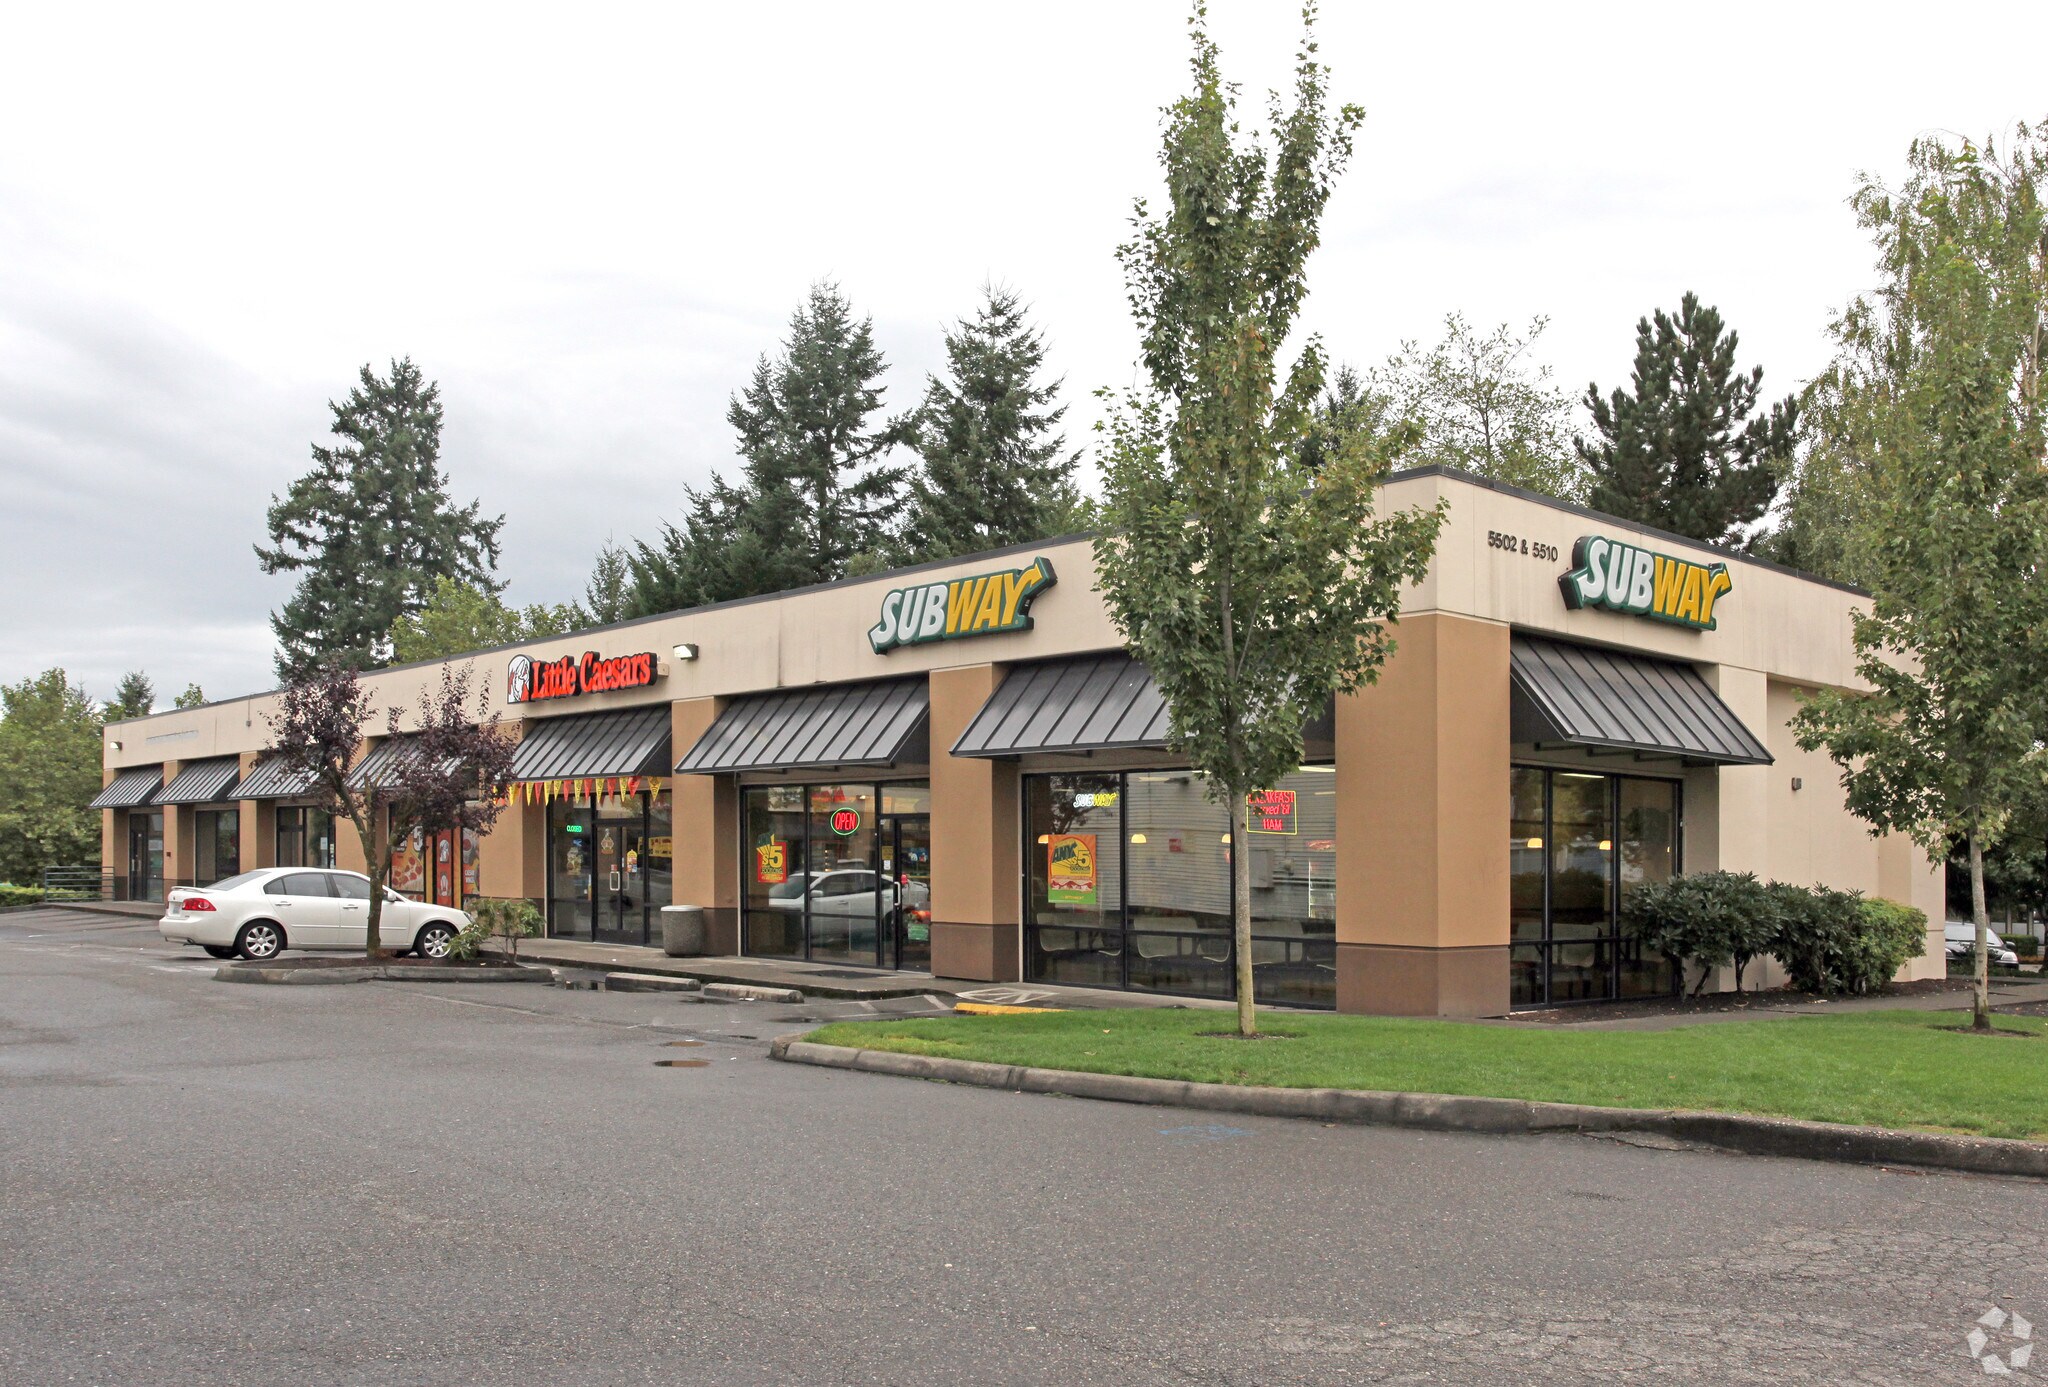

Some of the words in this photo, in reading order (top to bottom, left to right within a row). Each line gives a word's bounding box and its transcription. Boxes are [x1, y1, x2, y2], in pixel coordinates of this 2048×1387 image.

[1487, 530, 1517, 552] 5502
[1520, 539, 1529, 555] &
[1532, 541, 1559, 562] 5510
[1576, 538, 1731, 624] SUBWAY
[870, 563, 1043, 648] SUBWAY
[531, 655, 577, 699] Little
[579, 651, 651, 693] Caesars
[1073, 793, 1118, 807] SUBWAY
[1253, 804, 1279, 815] rved
[834, 812, 856, 831] OPEN
[1263, 818, 1282, 831] 11AM
[762, 845, 783, 868] $5
[1072, 850, 1091, 868] $5
